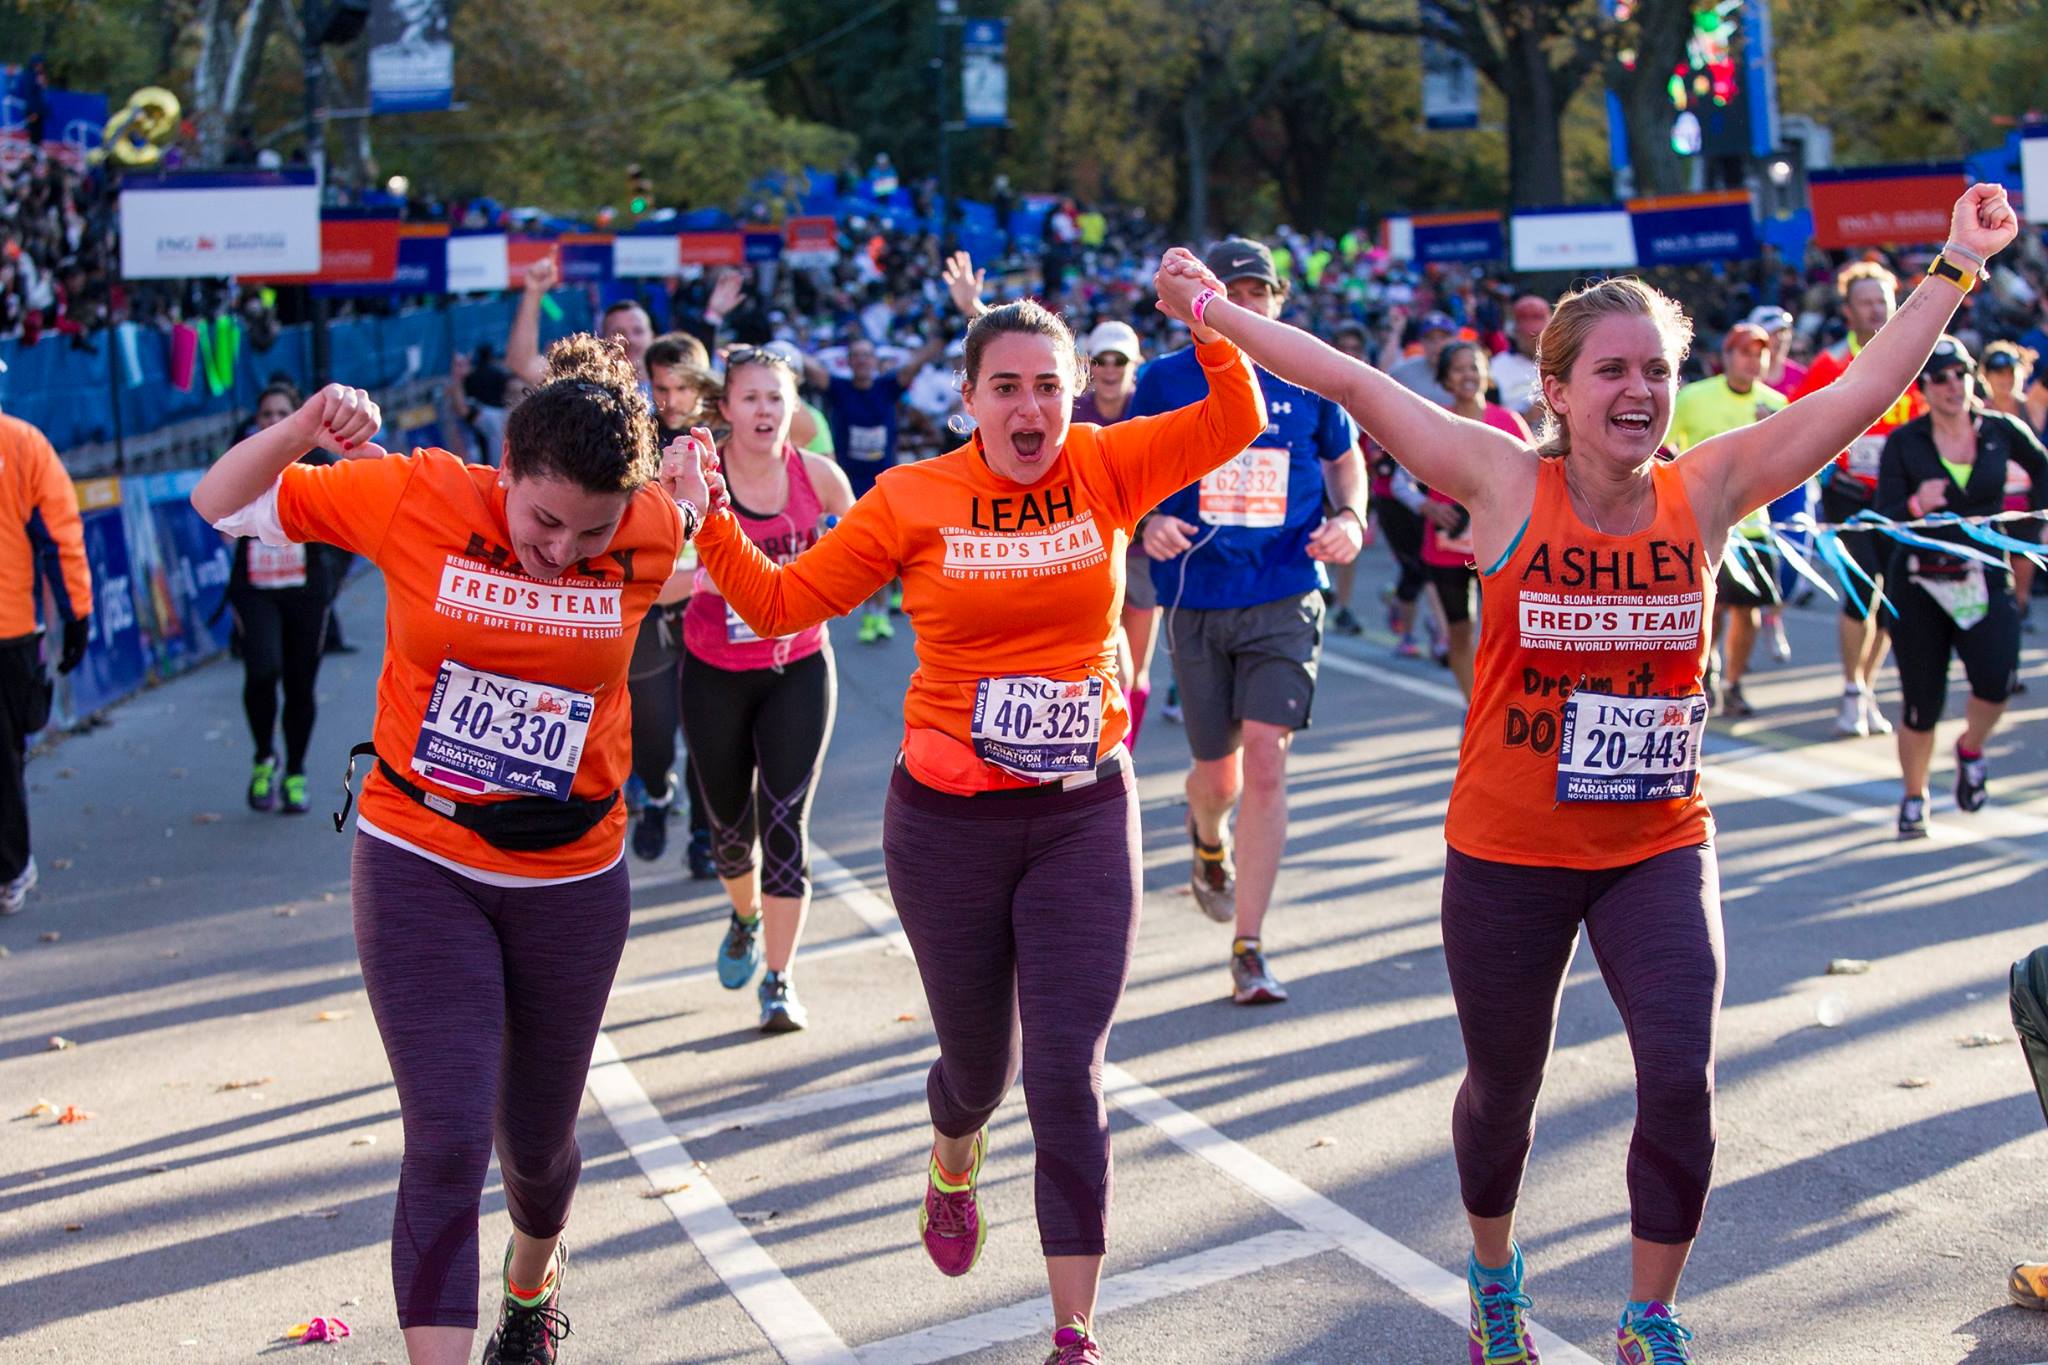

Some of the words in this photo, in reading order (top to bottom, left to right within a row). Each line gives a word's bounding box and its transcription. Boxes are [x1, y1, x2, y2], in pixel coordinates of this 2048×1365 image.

[972, 486, 1074, 532] LEAH
[939, 527, 976, 536] MEMORIAL
[1050, 520, 1075, 533] CANCER
[952, 542, 1030, 558] FRED'S
[1040, 528, 1093, 556] TEAM
[446, 555, 487, 572] MEMORIAL
[566, 578, 594, 588] CANCER
[968, 570, 979, 580] OF
[984, 569, 1007, 580] HOPE
[1012, 568, 1029, 579] FOR
[1033, 565, 1068, 577] CANCER
[1071, 552, 1108, 571] RESEARCH
[1522, 541, 1696, 591] ASHLEY
[451, 575, 540, 610] FRED'S
[551, 594, 614, 615] TEAM
[1519, 590, 1561, 604] MEMORIAL
[1563, 594, 1643, 605] SLOAN-KETTERING
[1645, 593, 1679, 605] CANCER
[1680, 591, 1703, 603] CENTER
[434, 603, 462, 620] MILES
[466, 612, 479, 624] OF
[484, 616, 509, 630] HOPE
[514, 621, 533, 634] FOR
[538, 624, 578, 638] CANCER
[1527, 609, 1618, 631] FRED'S
[1628, 609, 1696, 631] TEAM
[1520, 638, 1562, 651] IMAGINE
[1564, 641, 1573, 651] A
[1574, 641, 1613, 651] WORLD
[1614, 640, 1662, 651] WITHOUT
[1664, 639, 1697, 651] CANCER
[429, 681, 446, 713] WAVE
[439, 672, 449, 682] 3
[467, 676, 529, 708] ING
[974, 691, 986, 724] WAVE
[980, 681, 988, 690] 3
[1006, 683, 1059, 700] ING
[450, 695, 566, 762] 40-330
[994, 700, 1090, 739] 40-325
[1567, 710, 1576, 719] 2
[1596, 705, 1656, 728] ING
[431, 736, 442, 745] THE
[1562, 721, 1575, 755] WAVE
[1584, 729, 1690, 769] 20-443
[426, 750, 466, 769] NOVEMBER
[476, 768, 494, 778] 2013
[428, 741, 497, 772] MARATHON
[1568, 783, 1636, 794] MARATHON
